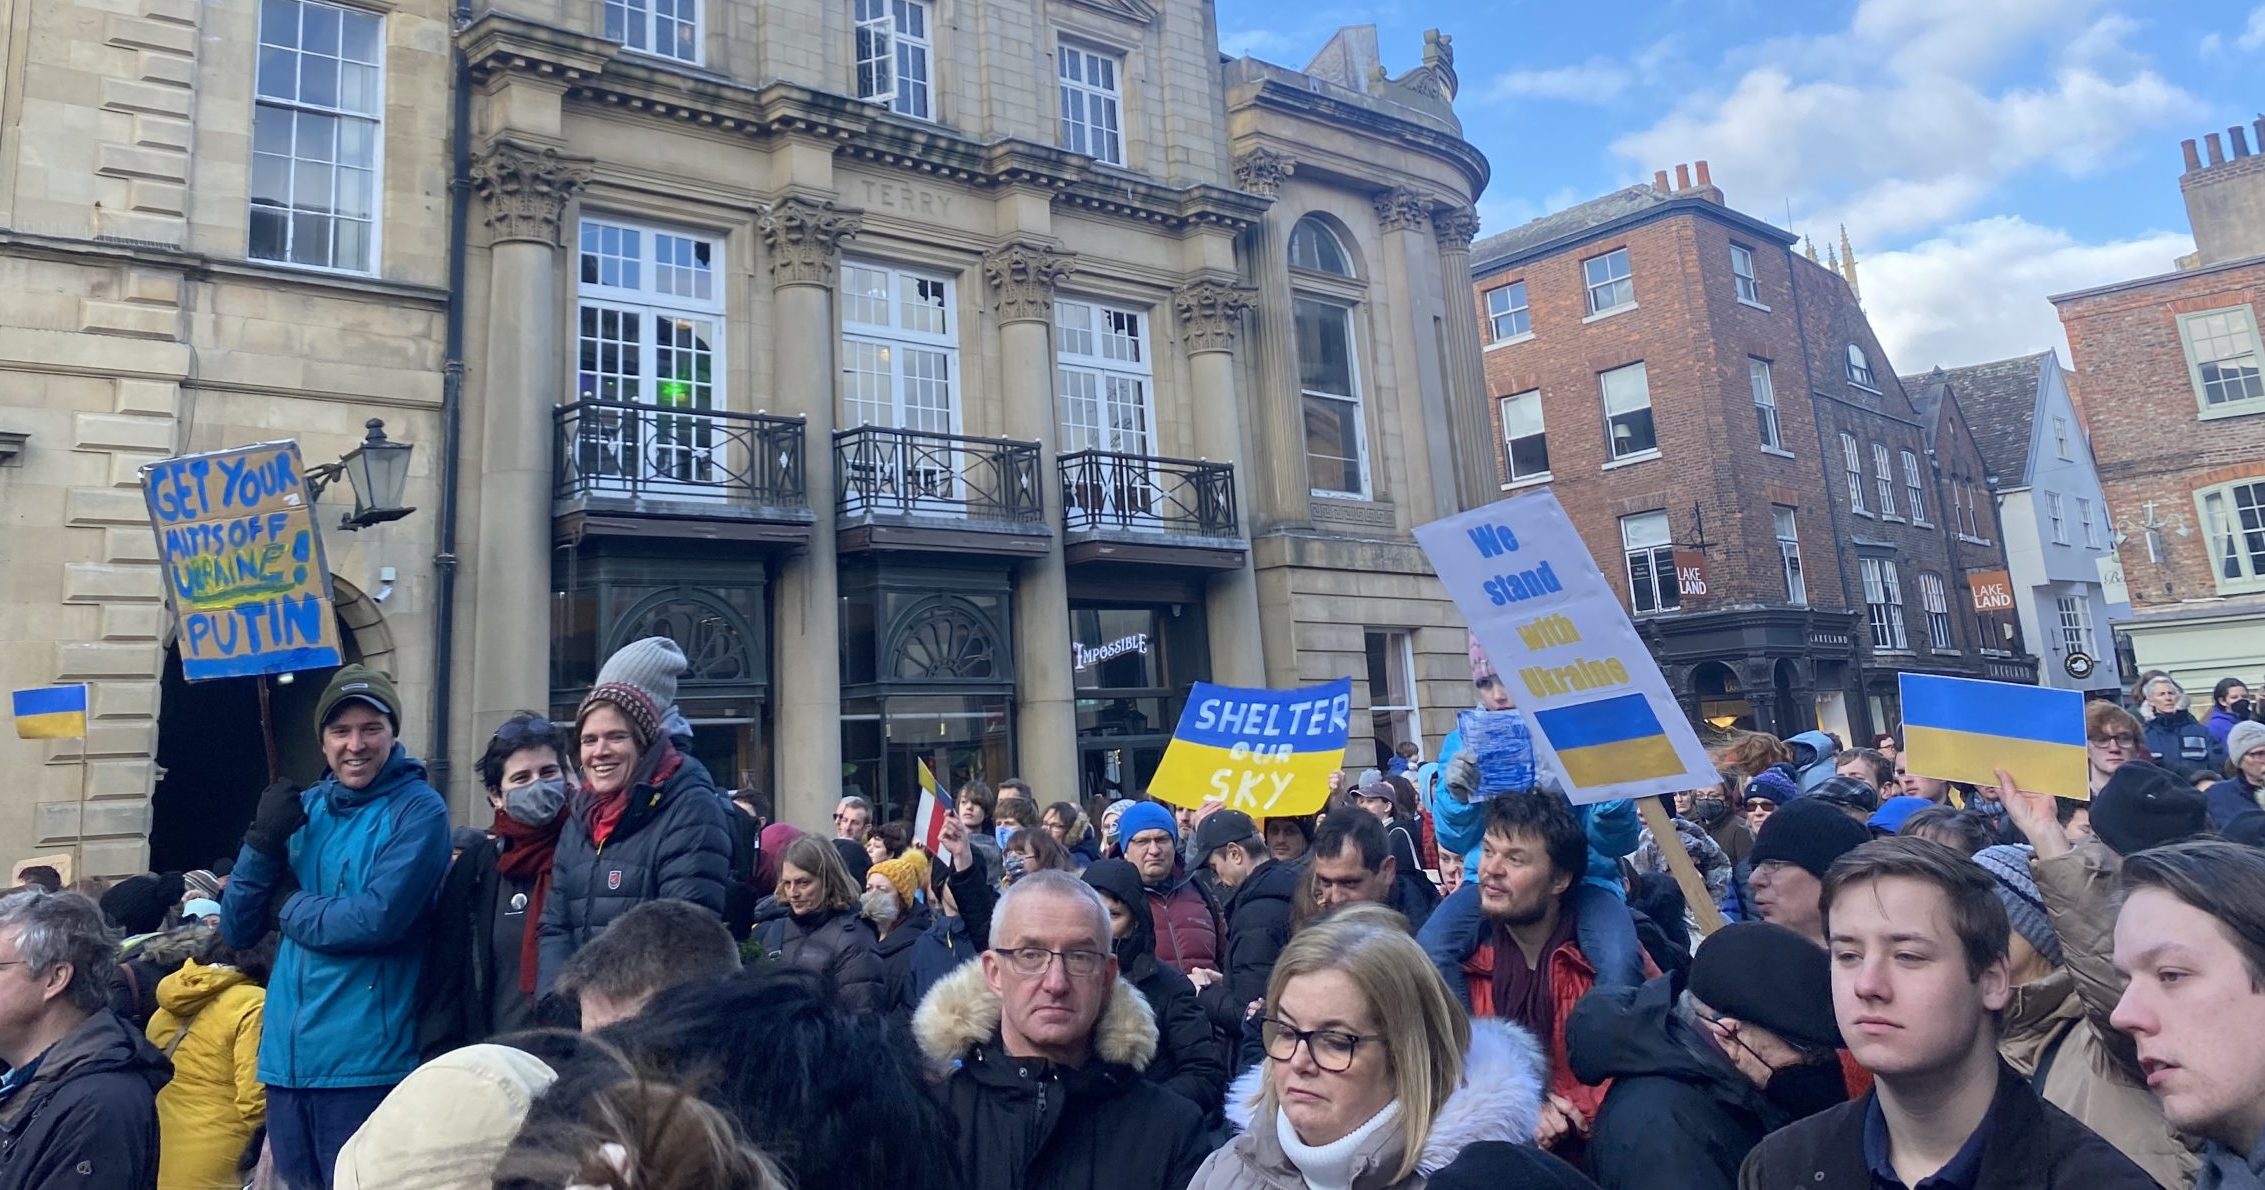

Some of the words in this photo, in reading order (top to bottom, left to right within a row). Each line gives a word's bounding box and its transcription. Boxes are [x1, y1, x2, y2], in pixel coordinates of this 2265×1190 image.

[862, 180, 952, 217] TERRY
[150, 458, 210, 522] GET
[217, 451, 299, 508] YOUR
[164, 523, 226, 564] MITTS
[228, 512, 289, 548] OFF
[1467, 523, 1520, 558] We
[1483, 560, 1564, 606] stand
[1677, 567, 1702, 581] LAKE
[1679, 580, 1707, 595] LAND
[1972, 584, 2004, 598] LAKE
[1974, 594, 2011, 609] LAND
[187, 592, 321, 657] PUTIN
[1515, 612, 1584, 652] with
[1810, 633, 1848, 644] LAKELAND
[1518, 656, 1630, 698] Ukraine
[1989, 663, 2030, 679] LAKELAND
[1194, 692, 1350, 736] SHELTER
[1229, 740, 1294, 765] OUR
[1202, 768, 1296, 811] SKY
